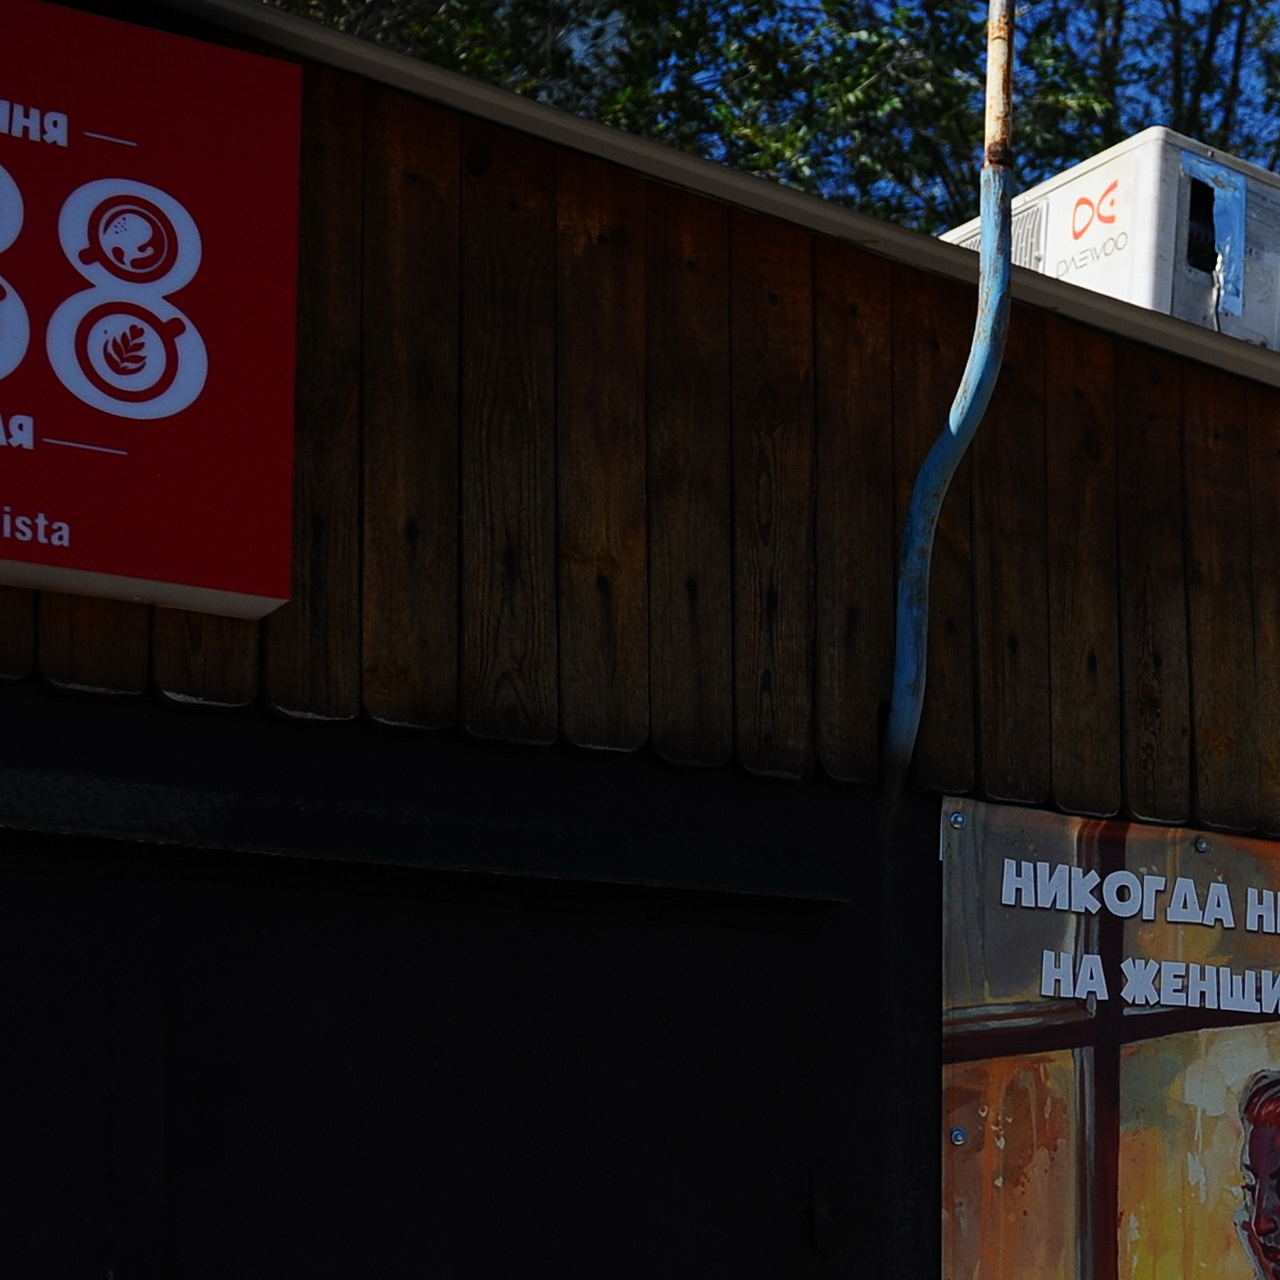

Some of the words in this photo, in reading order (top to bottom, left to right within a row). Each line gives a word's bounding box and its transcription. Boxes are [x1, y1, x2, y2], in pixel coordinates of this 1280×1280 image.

[1056, 231, 1129, 278] DAEWOO
[1001, 857, 1236, 929] НИКОГДА
[1040, 949, 1109, 1002] НА
